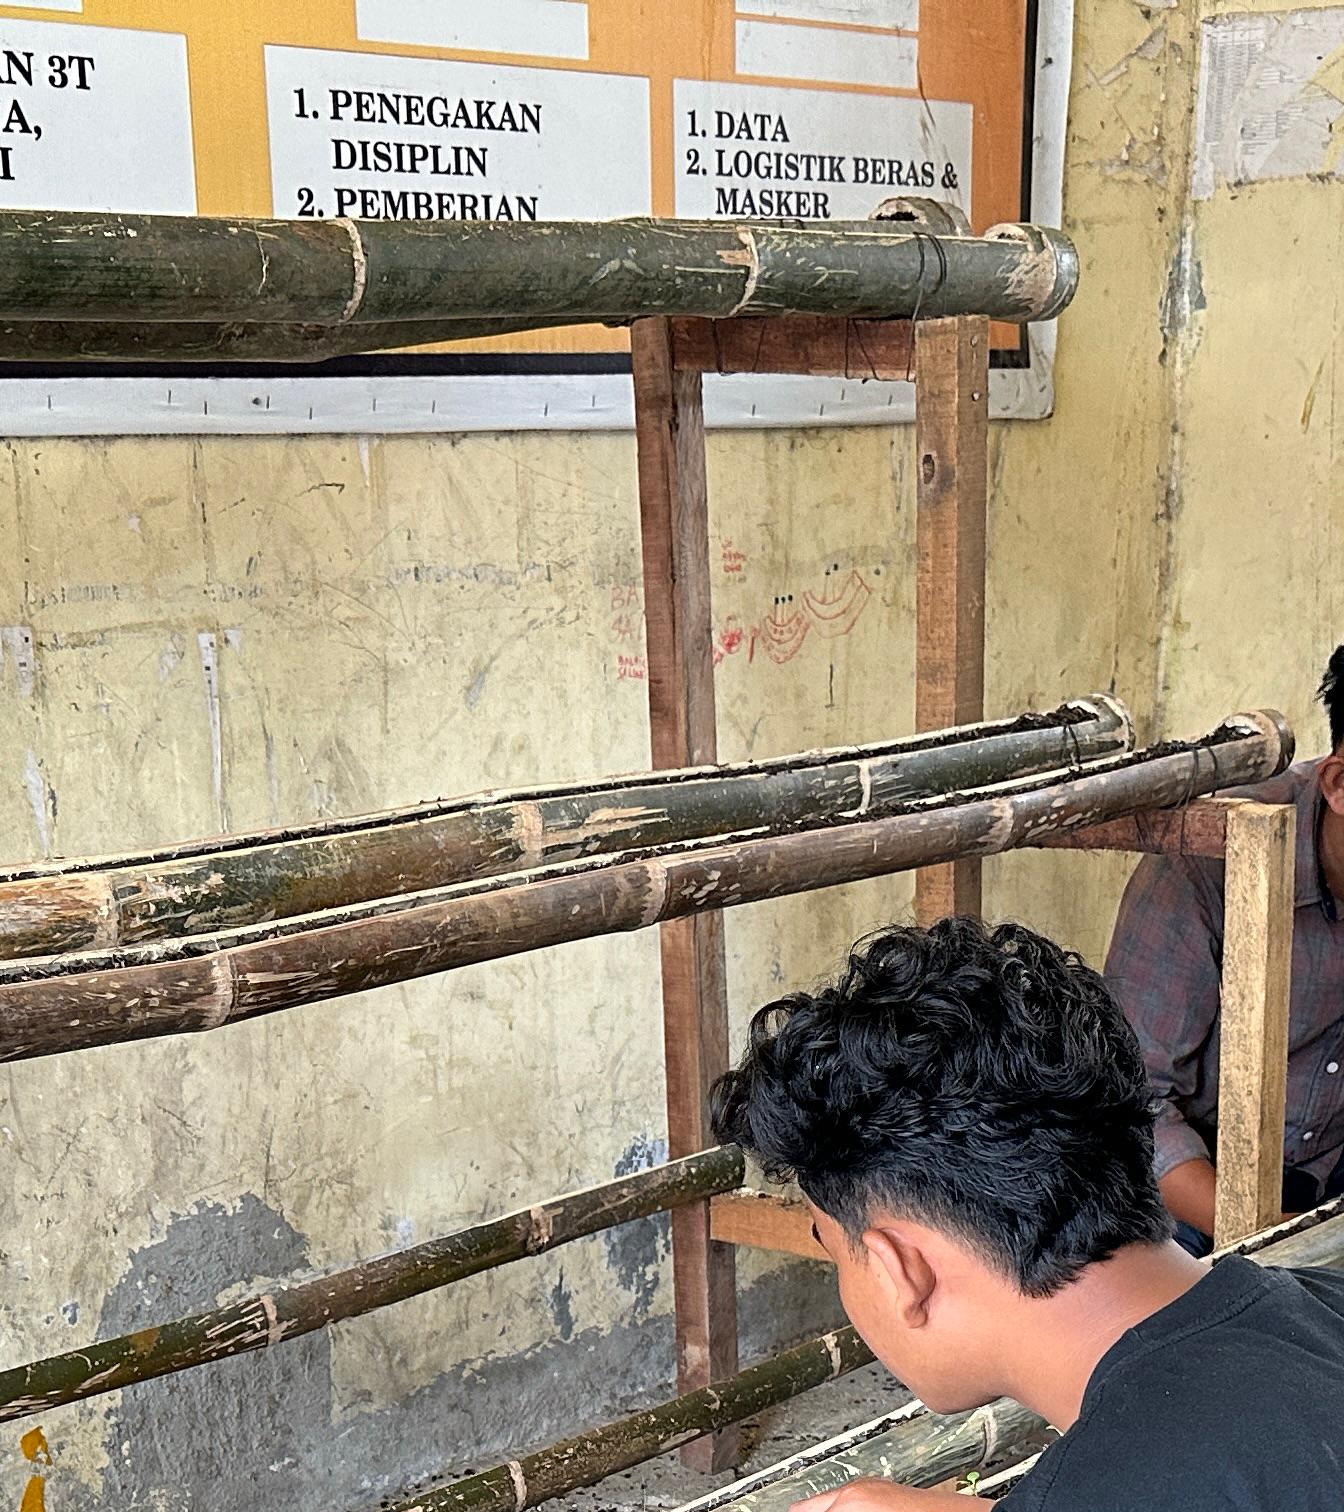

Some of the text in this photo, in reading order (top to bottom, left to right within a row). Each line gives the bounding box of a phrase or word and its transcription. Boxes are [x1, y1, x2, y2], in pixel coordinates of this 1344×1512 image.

[47, 55, 95, 91] 3T
[294, 88, 542, 134] 1. PENEGAKAN
[687, 109, 790, 143] 1. DATA
[331, 138, 488, 177] DISIPLIN
[686, 149, 959, 189] 2. LOGISTIK BERAS &
[297, 187, 539, 221] 2. PEMBERIAN
[715, 187, 831, 218] MASKER
